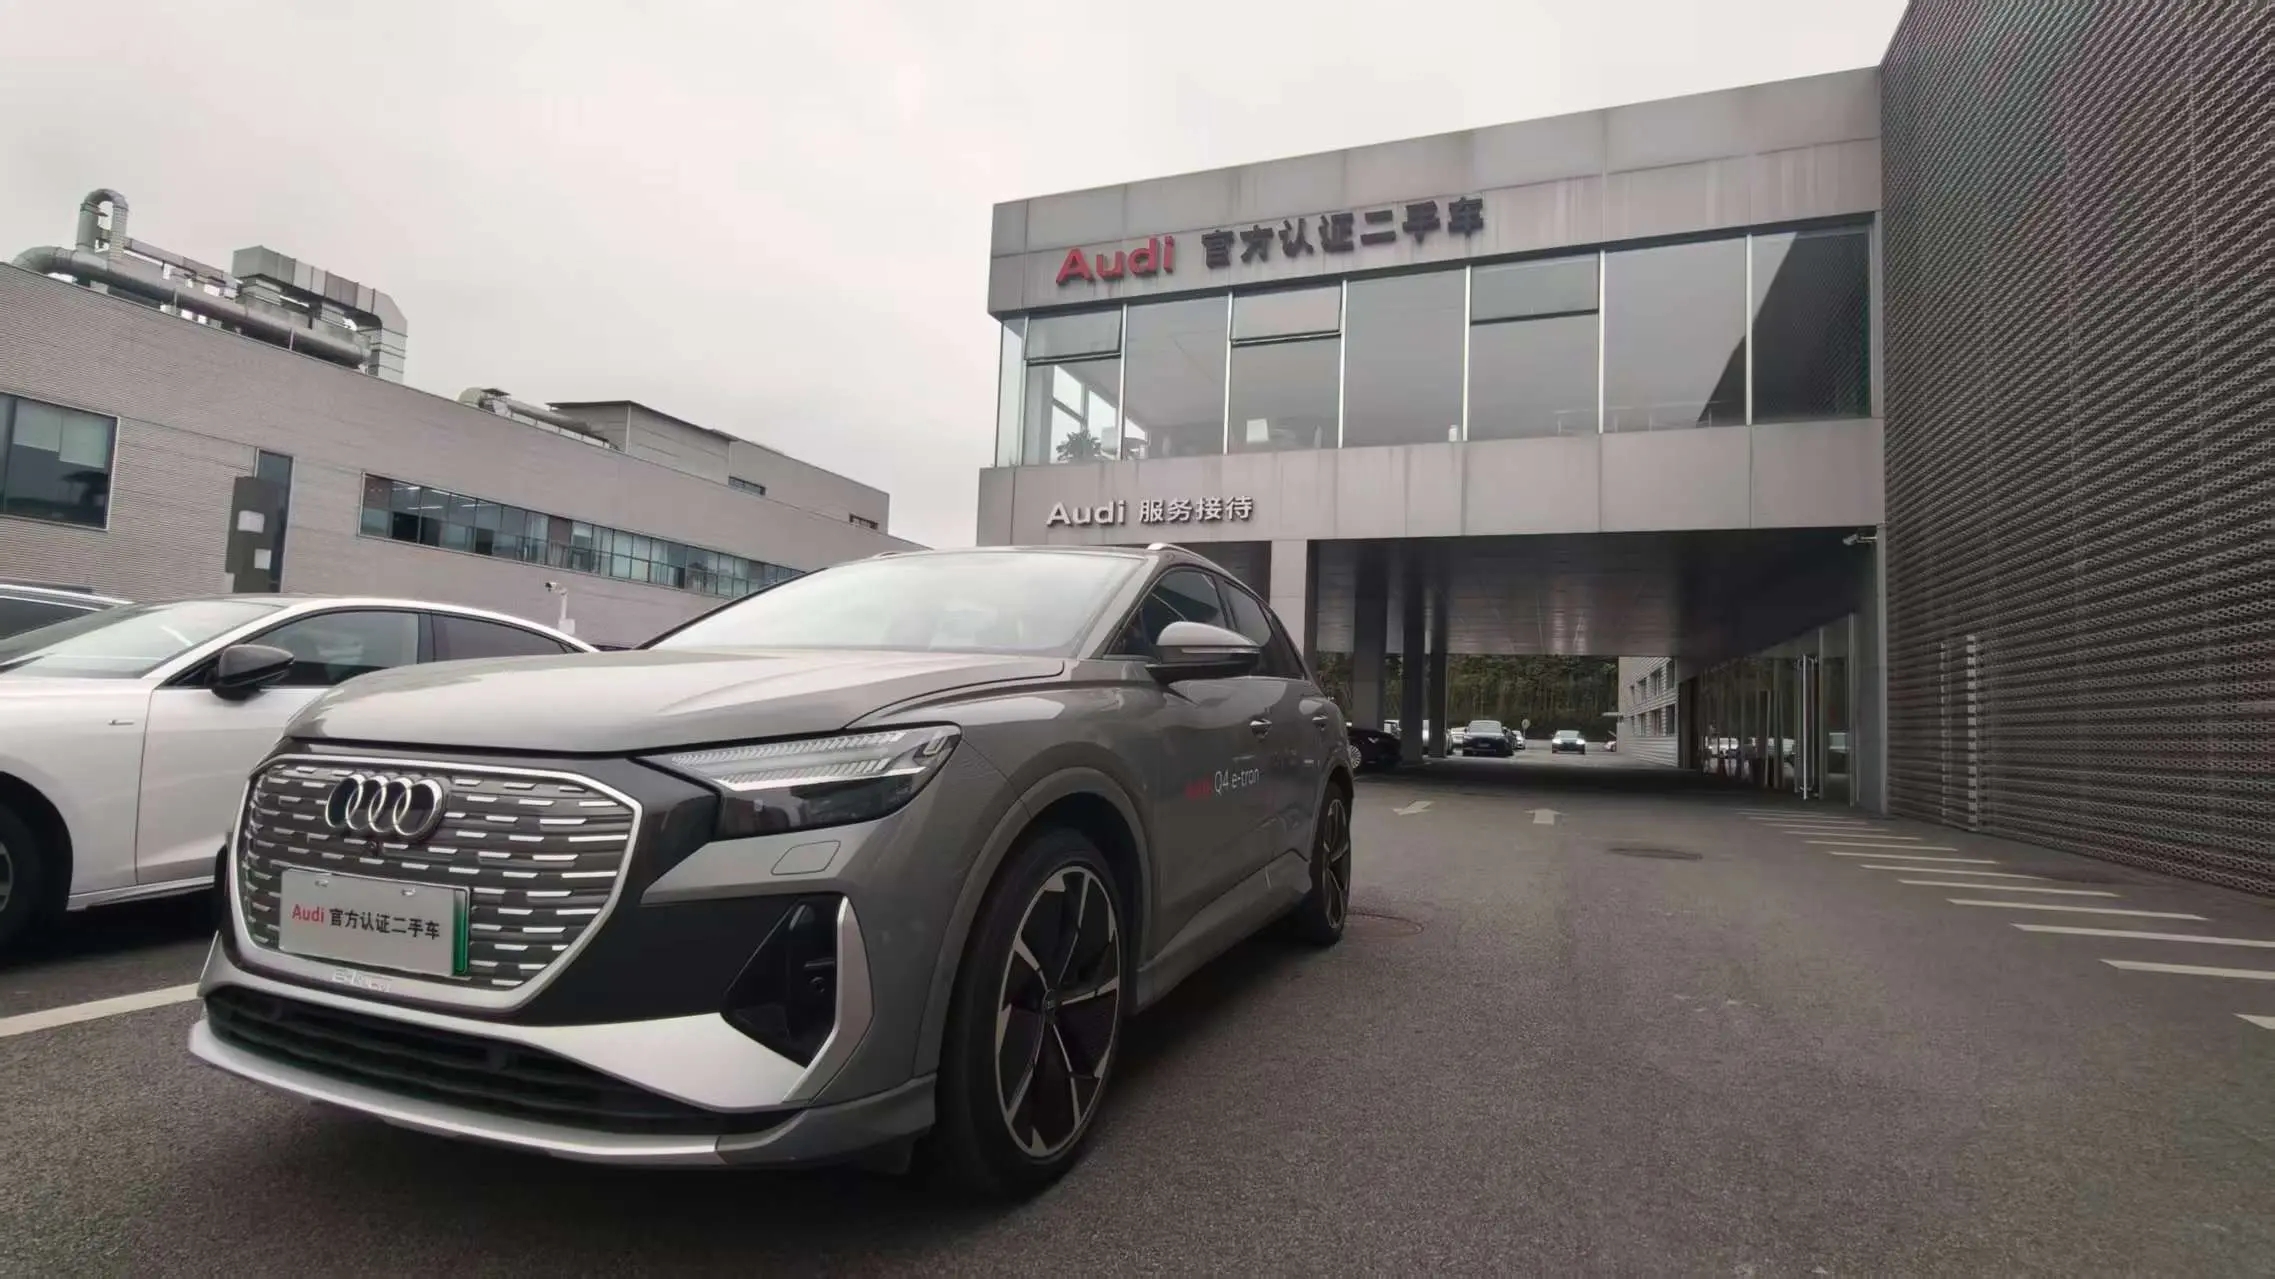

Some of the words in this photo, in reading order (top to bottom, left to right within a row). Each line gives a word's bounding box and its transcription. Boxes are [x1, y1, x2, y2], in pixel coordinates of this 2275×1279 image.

[1056, 234, 1176, 286] Audi
[1201, 195, 1486, 269] 官方认证二手车
[1046, 499, 1127, 527] Audi
[1139, 495, 1254, 524] 服务接待
[1214, 769, 1229, 796] Q4
[291, 902, 325, 924] Audi
[329, 906, 440, 940] 官方认证二手车
